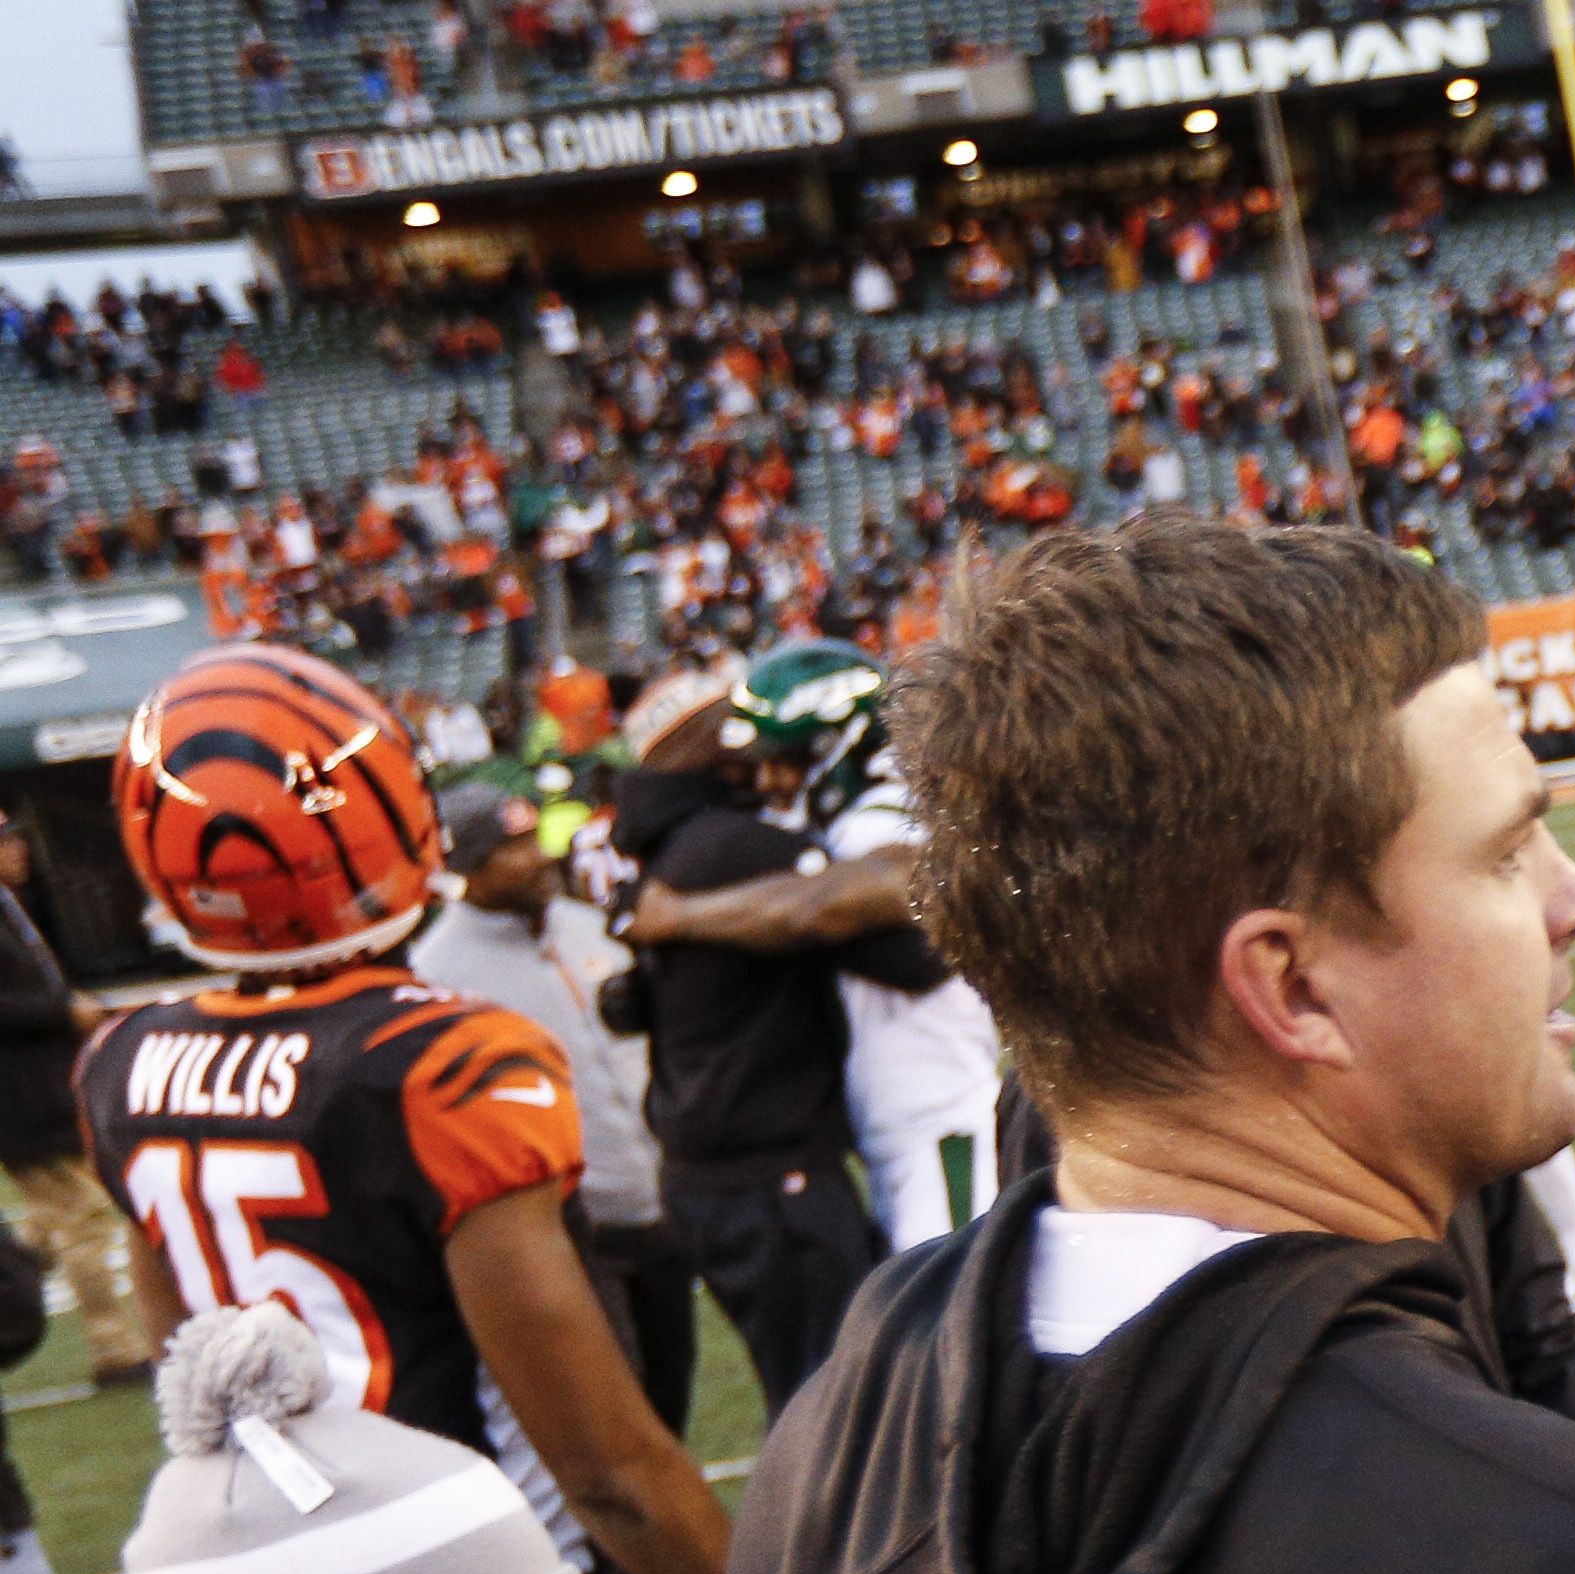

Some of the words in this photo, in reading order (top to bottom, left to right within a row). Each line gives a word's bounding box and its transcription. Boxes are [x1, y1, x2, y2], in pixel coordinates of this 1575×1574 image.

[1063, 10, 1491, 115] HILLMAN
[127, 1031, 310, 1118] WILLIS
[124, 1137, 394, 1414] 15
